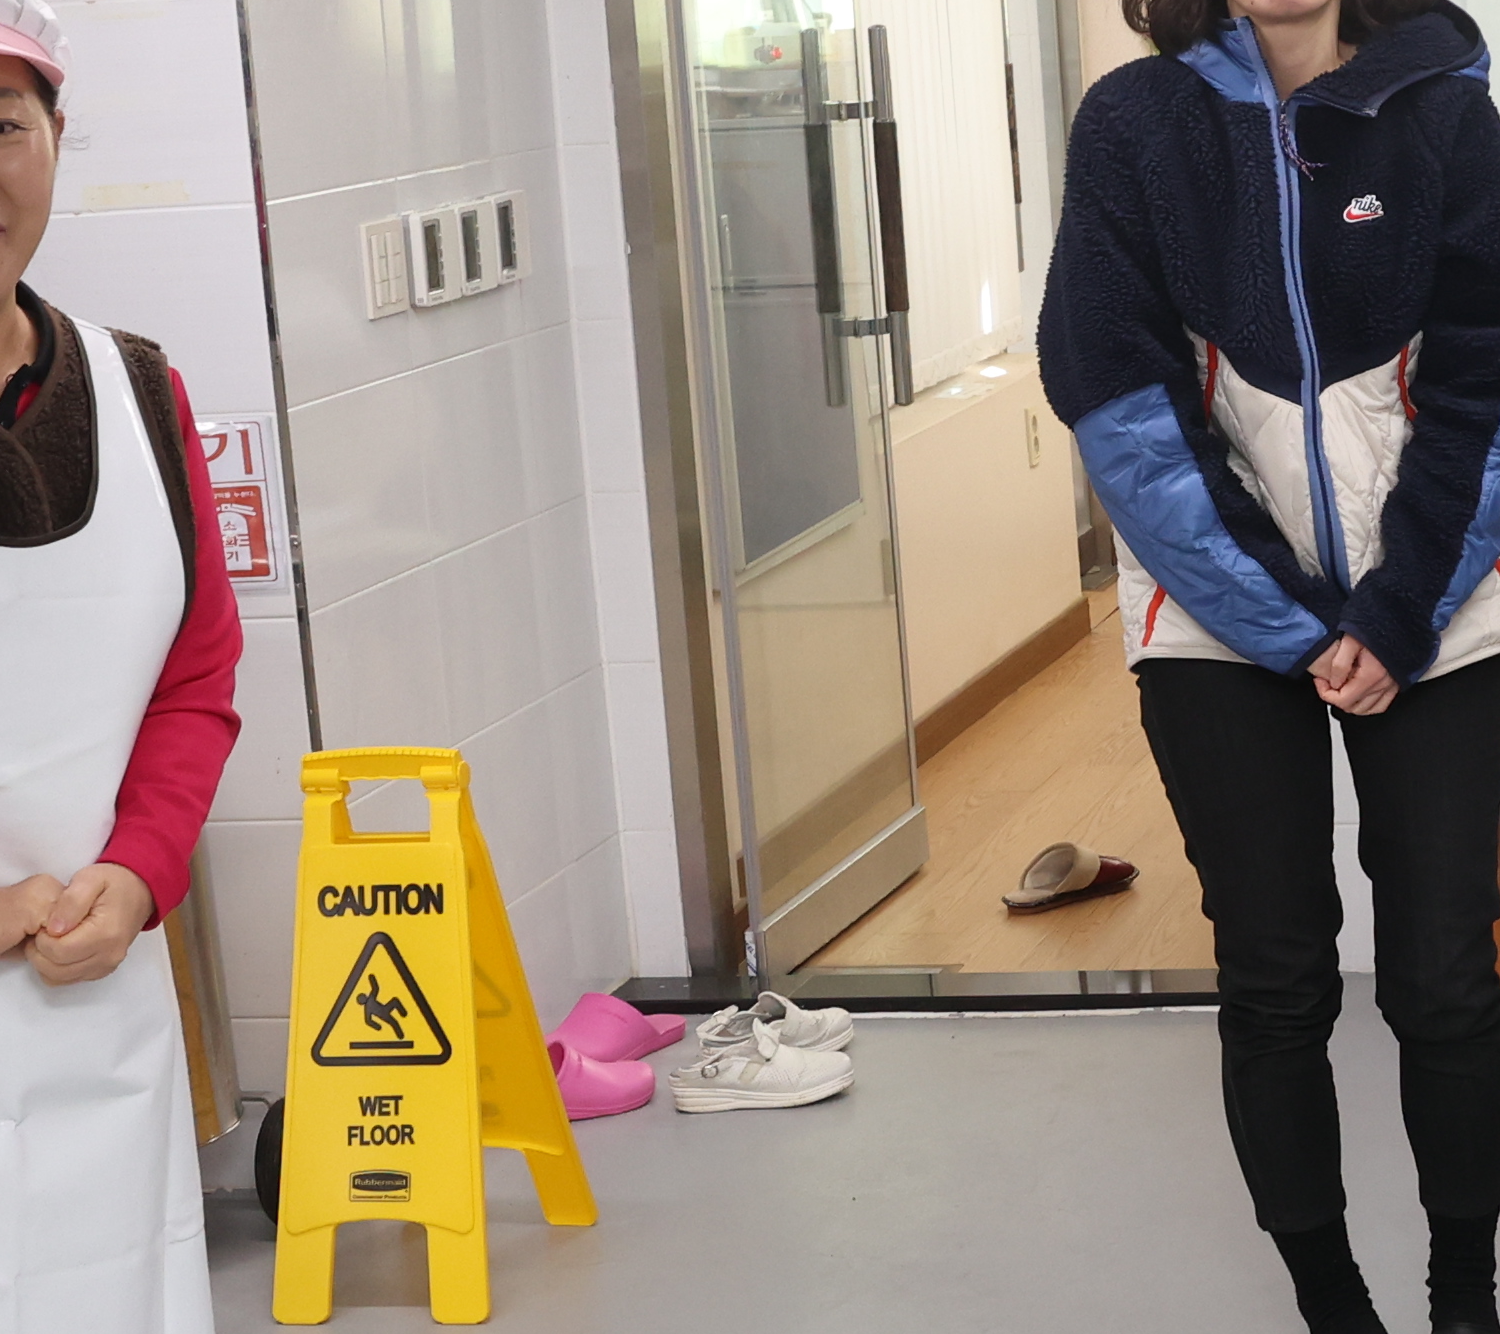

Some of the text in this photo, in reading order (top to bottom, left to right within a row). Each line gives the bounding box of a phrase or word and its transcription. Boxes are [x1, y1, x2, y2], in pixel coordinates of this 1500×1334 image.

[1353, 196, 1382, 214] nike
[317, 883, 444, 918] CAUTION
[358, 1095, 404, 1117] WET
[347, 1124, 416, 1147] FLOOR
[354, 1178, 406, 1186] Rubbermaid
